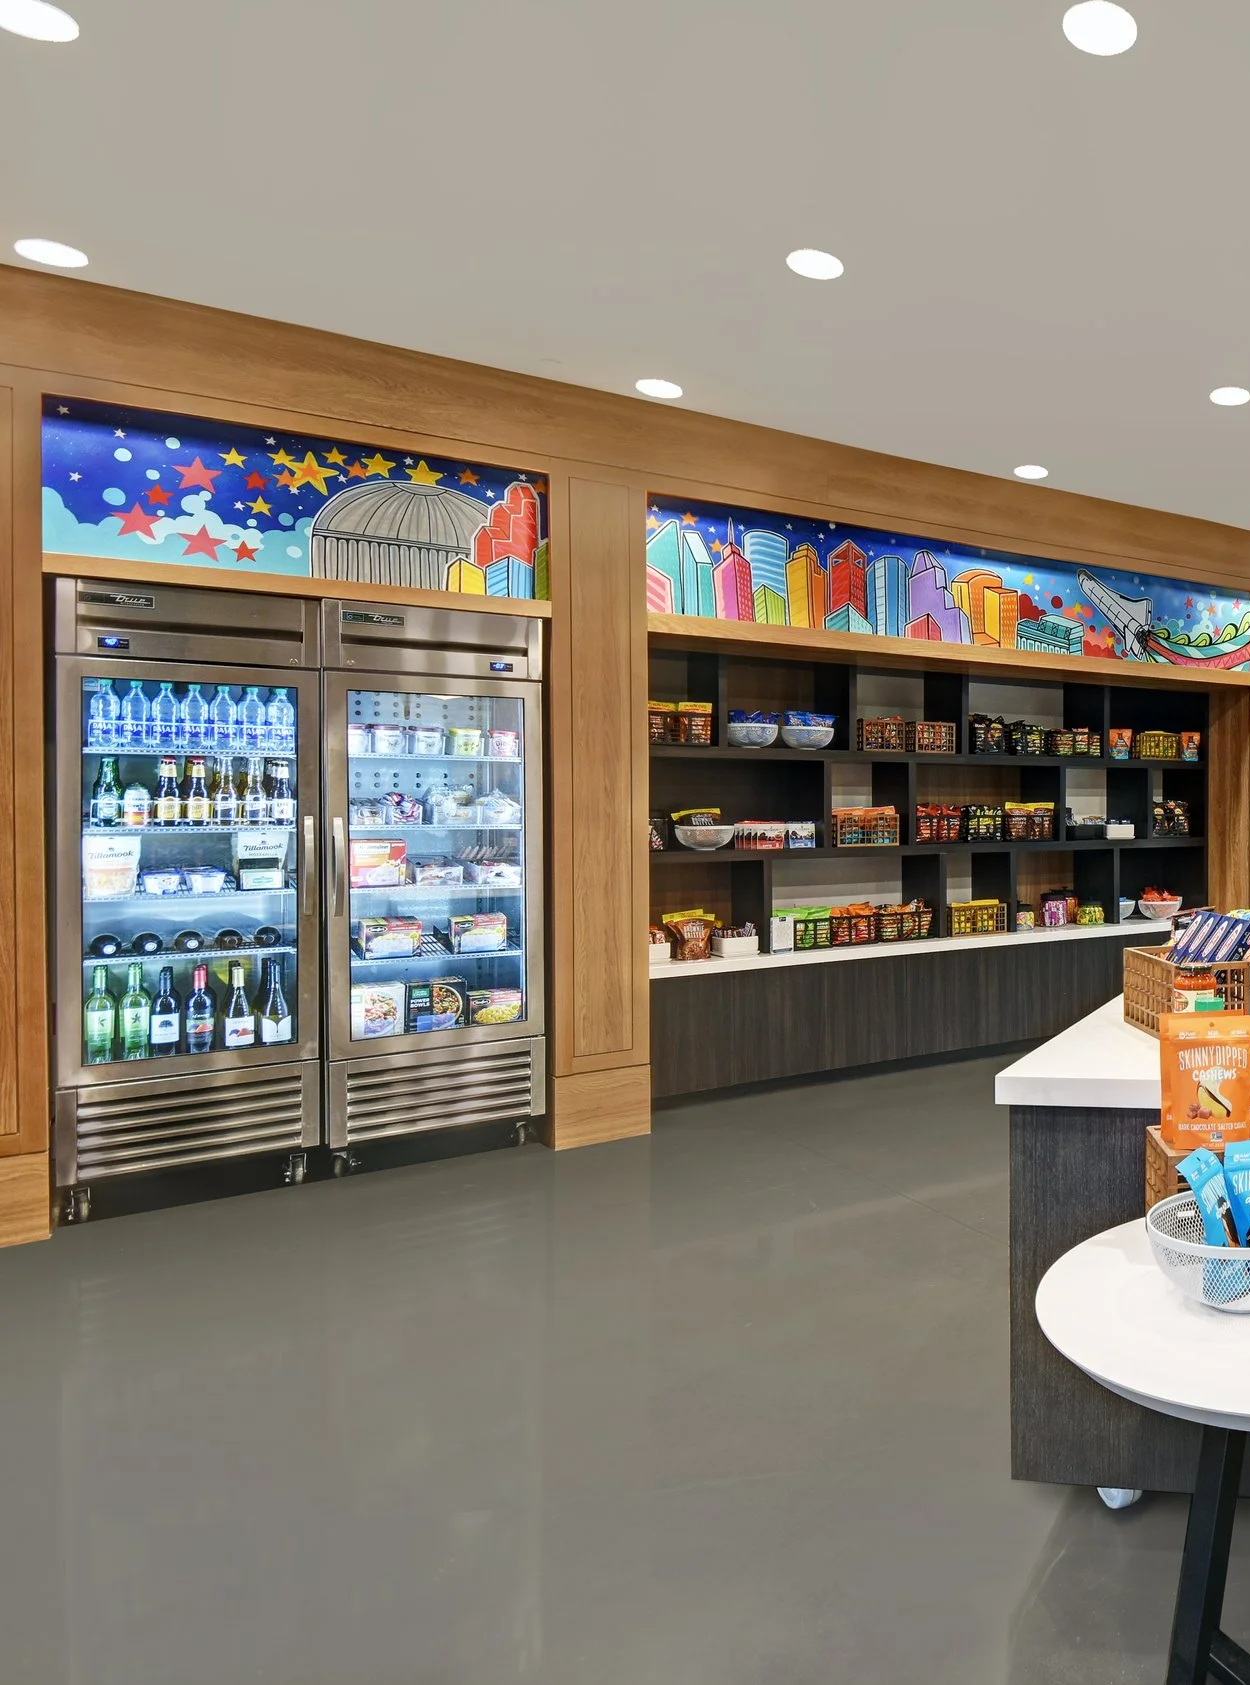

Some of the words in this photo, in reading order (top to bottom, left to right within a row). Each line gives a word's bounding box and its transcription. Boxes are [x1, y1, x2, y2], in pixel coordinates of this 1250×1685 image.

[110, 594, 150, 604] True
[368, 614, 402, 624] True
[243, 843, 283, 851] Tillamook
[88, 850, 134, 860] Tillamook
[1179, 1046, 1248, 1071] SKINNYDIPPED
[1192, 1068, 1237, 1082] CASHEWS
